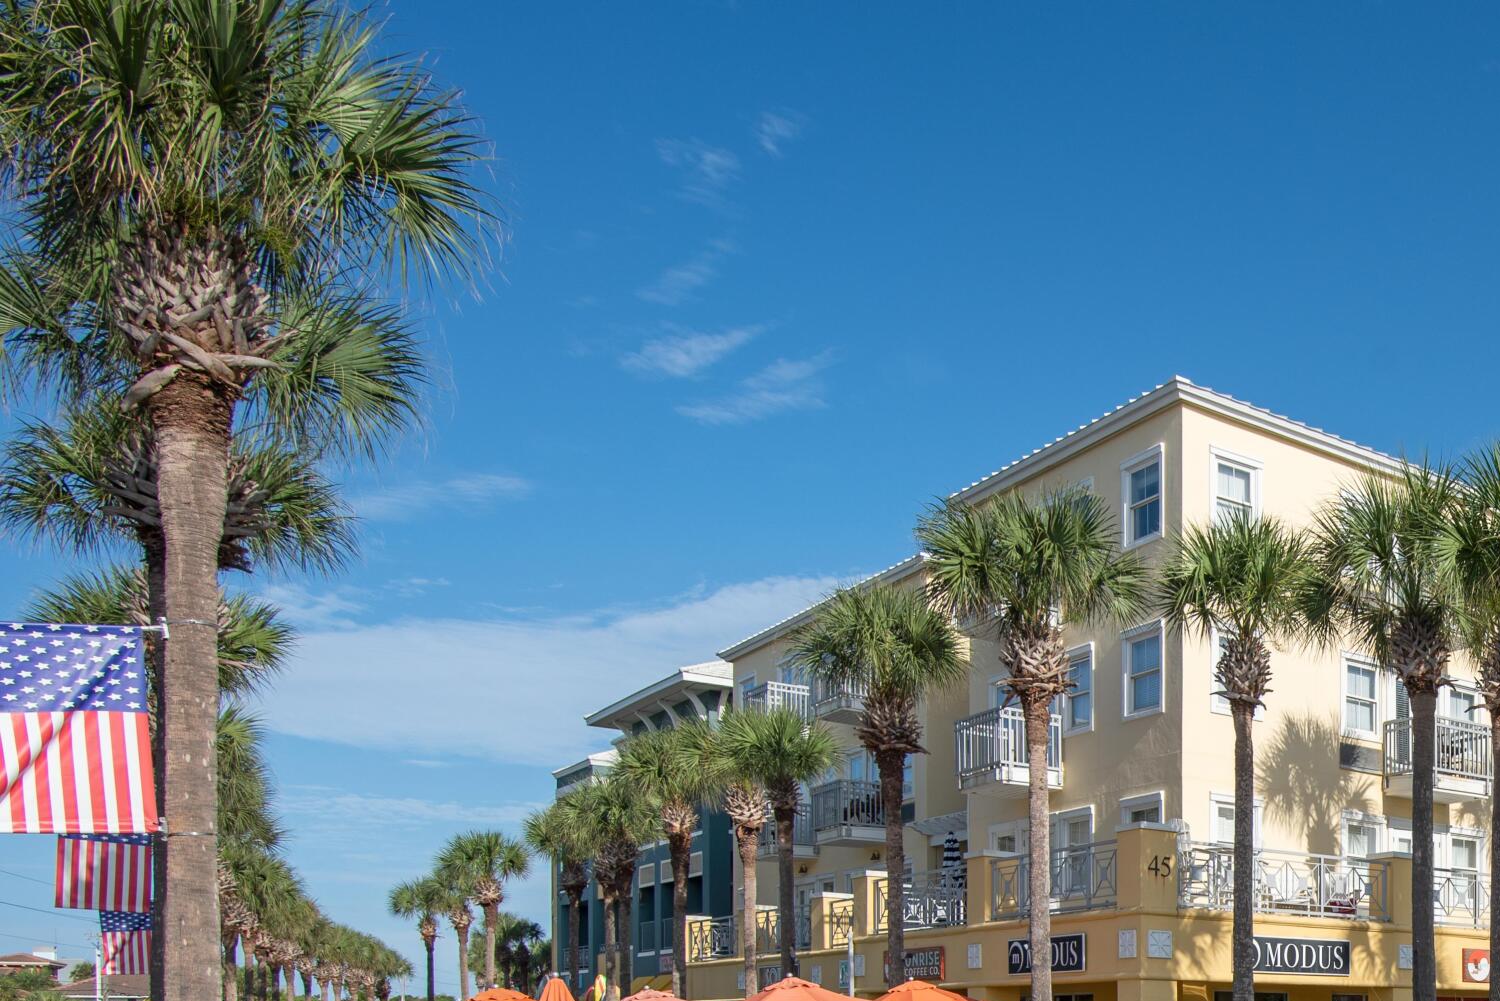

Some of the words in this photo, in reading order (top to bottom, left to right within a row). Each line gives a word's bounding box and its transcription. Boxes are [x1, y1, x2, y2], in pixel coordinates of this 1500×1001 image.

[1148, 855, 1171, 877] 45
[904, 951, 940, 968] UNRISE
[1265, 943, 1344, 970] MODUS
[904, 967, 928, 977] COFFEE
[929, 965, 940, 976] CO.
